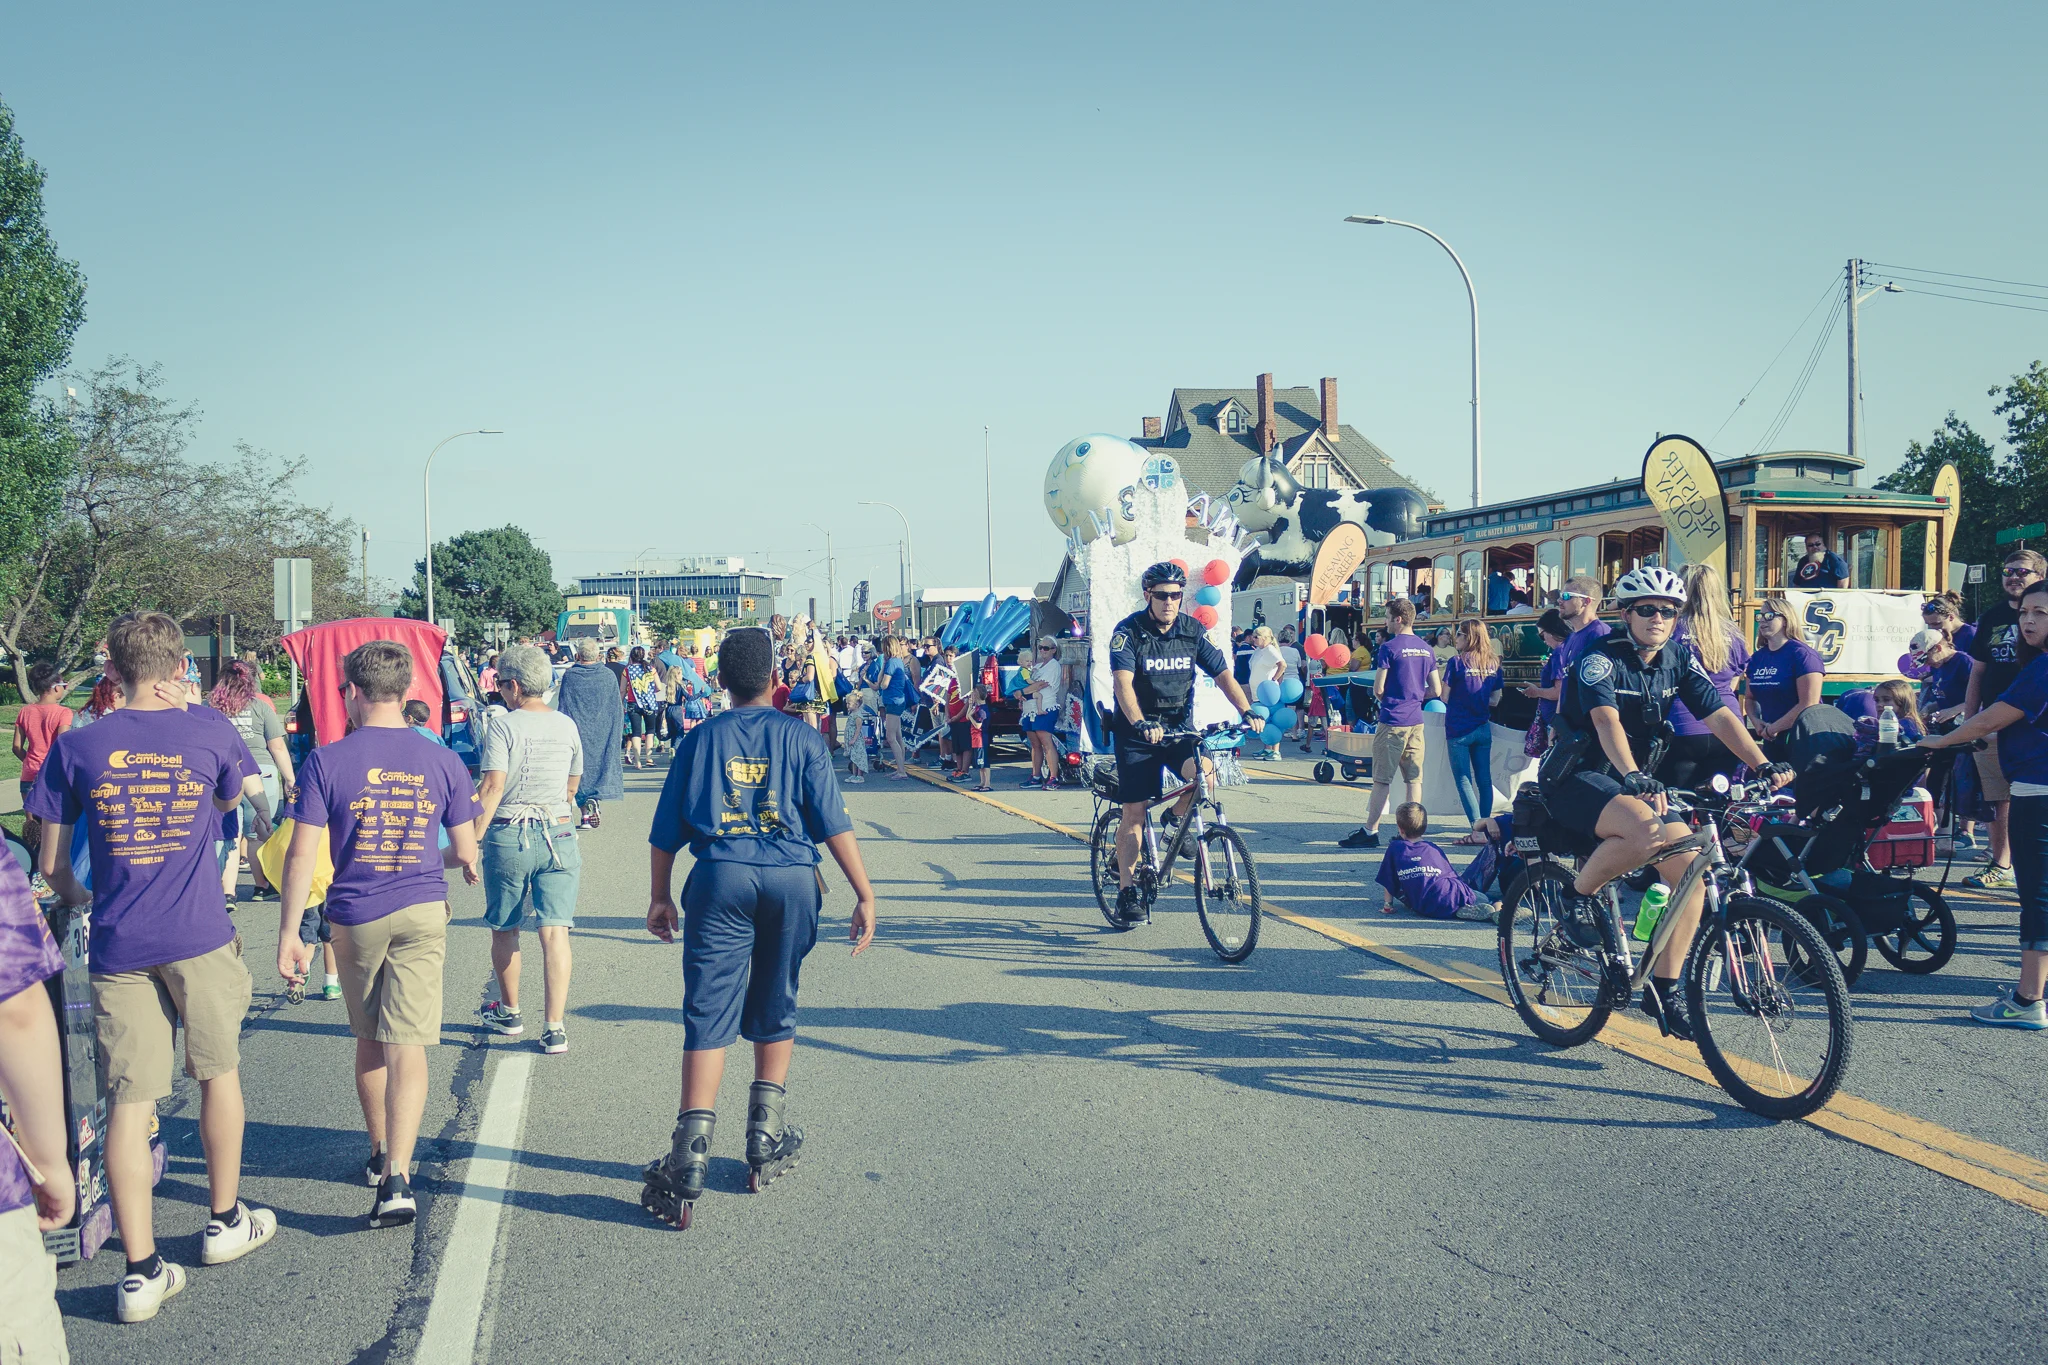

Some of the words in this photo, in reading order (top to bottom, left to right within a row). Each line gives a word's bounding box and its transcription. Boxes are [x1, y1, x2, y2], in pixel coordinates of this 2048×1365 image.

[1475, 530, 1487, 539] BLUE
[1487, 527, 1502, 537] WATER
[1503, 525, 1517, 534] AREA
[1517, 521, 1538, 531] TRANSIT
[1316, 535, 1354, 591] LIFESAVING
[1330, 551, 1357, 588] CAREER
[1886, 625, 1917, 633] COUNTY
[1991, 644, 2017, 657] adv
[1146, 657, 1191, 671] POLICE
[1518, 668, 1540, 677] TROLLE
[126, 755, 183, 766] Campbell
[731, 761, 768, 774] BEST
[380, 772, 425, 783] Campbell
[732, 773, 766, 784] BUY
[90, 785, 123, 799] Cargill
[129, 785, 170, 794] BIOPRO
[177, 782, 205, 793] BTM
[417, 800, 437, 811] BTM
[760, 810, 779, 820] BTM
[1516, 839, 1538, 848] POLICE
[1690, 924, 1715, 982] SPECIALIZ
